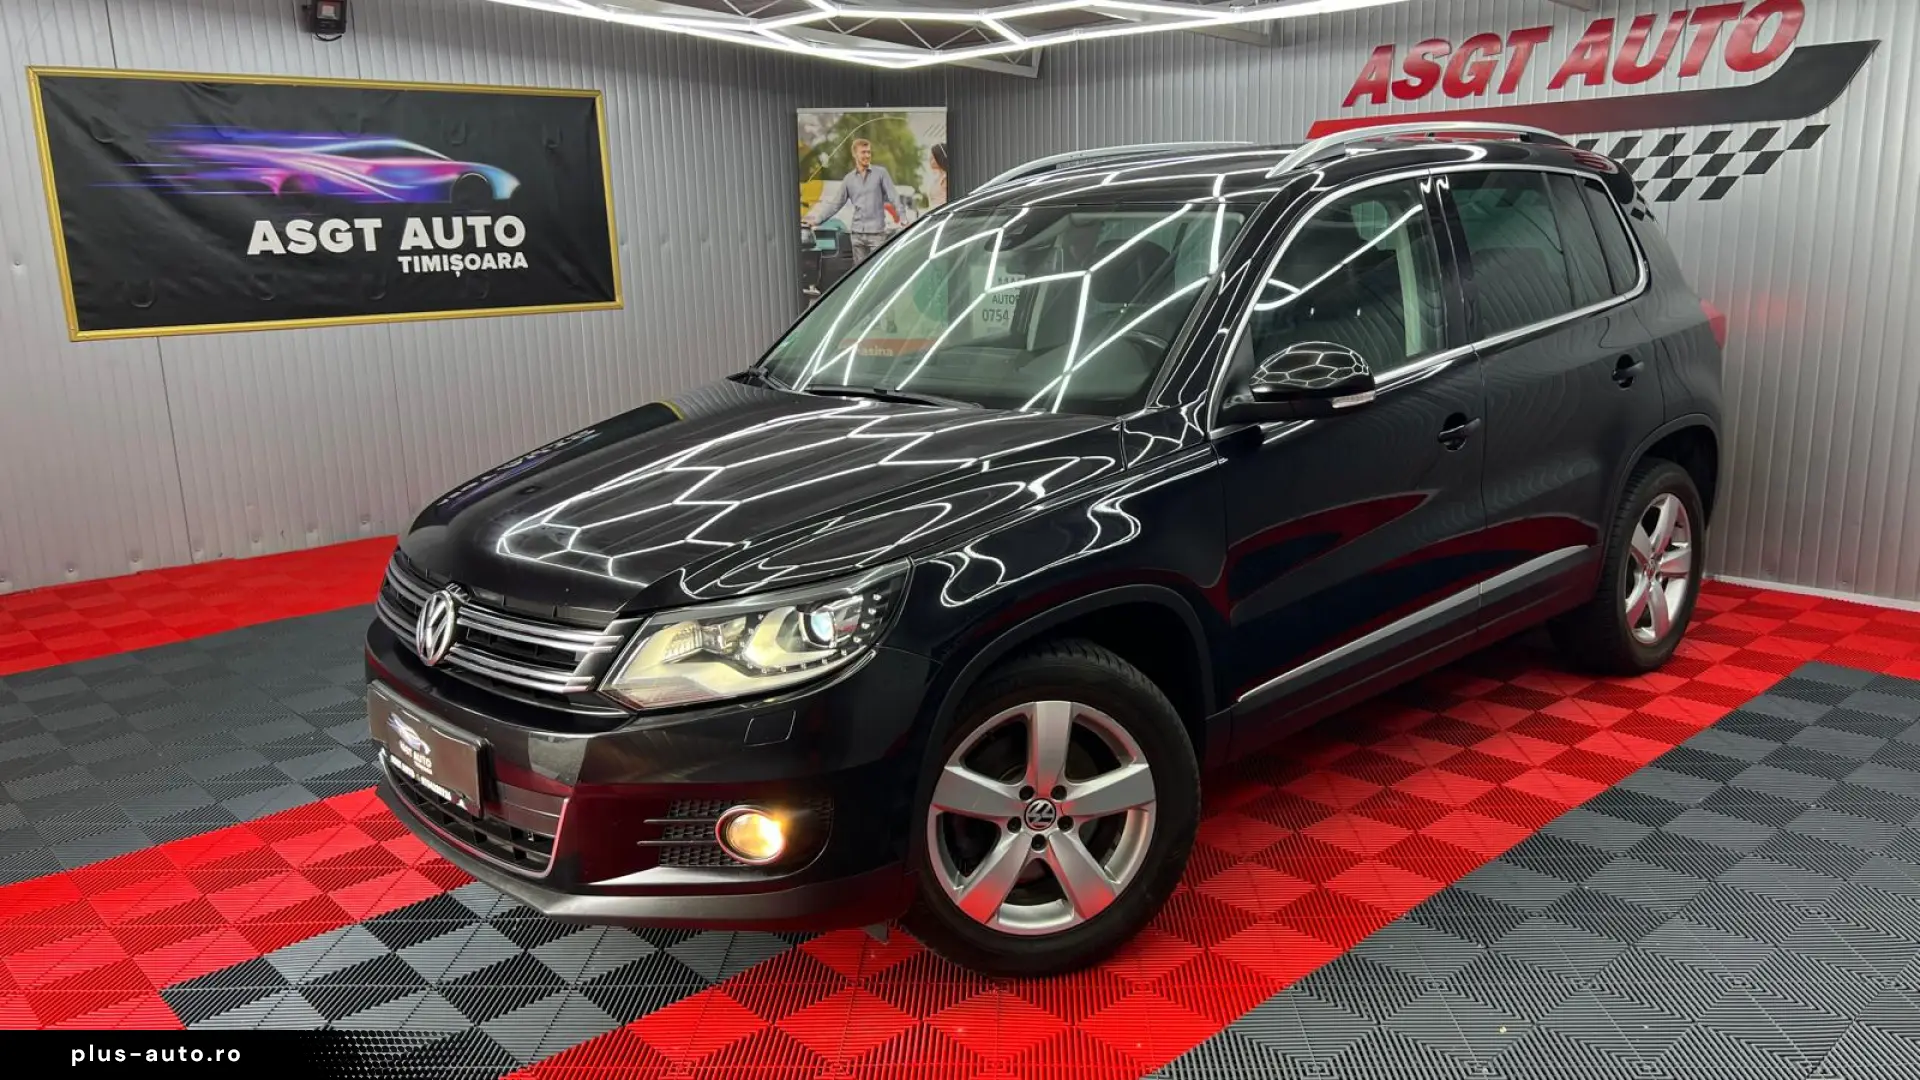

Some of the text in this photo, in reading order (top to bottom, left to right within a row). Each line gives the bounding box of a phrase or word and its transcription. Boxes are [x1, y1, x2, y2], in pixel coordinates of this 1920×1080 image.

[1342, 0, 1804, 107] ASGT AUTO
[247, 215, 526, 255] ASGT AUTO
[397, 251, 528, 277] TIMIȘOARA
[982, 309, 1010, 322] 0754
